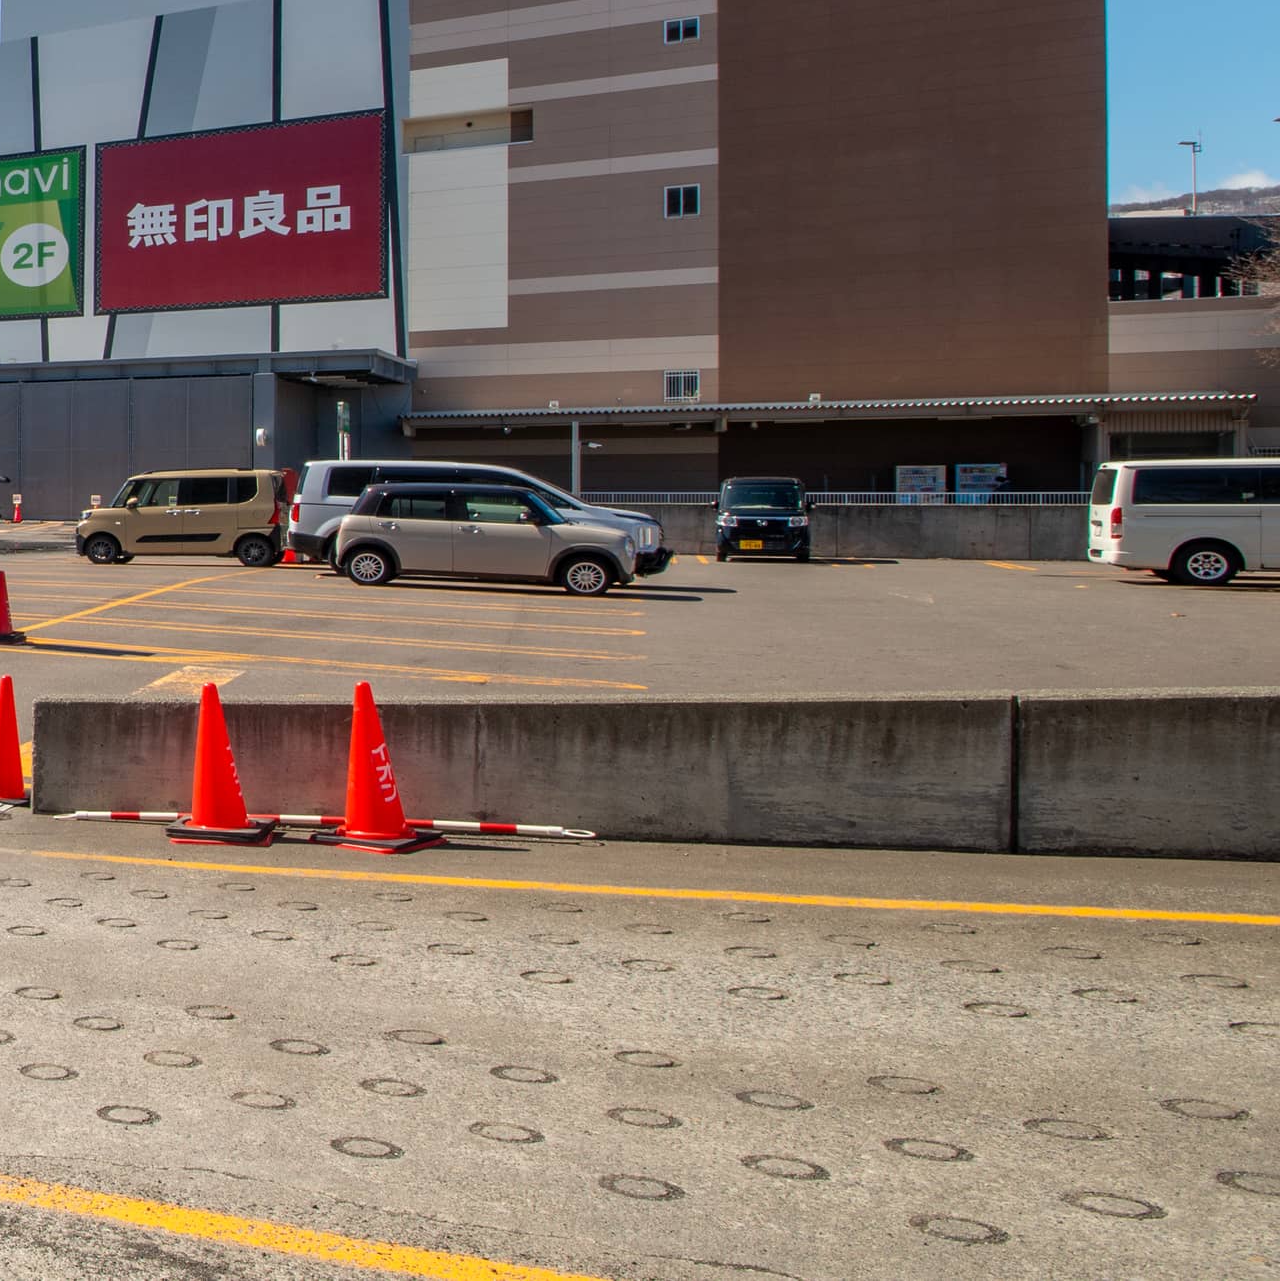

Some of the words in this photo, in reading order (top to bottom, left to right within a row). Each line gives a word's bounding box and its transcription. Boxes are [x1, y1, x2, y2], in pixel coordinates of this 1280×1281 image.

[126, 184, 351, 249] 無印良品
[12, 240, 57, 270] 2F
